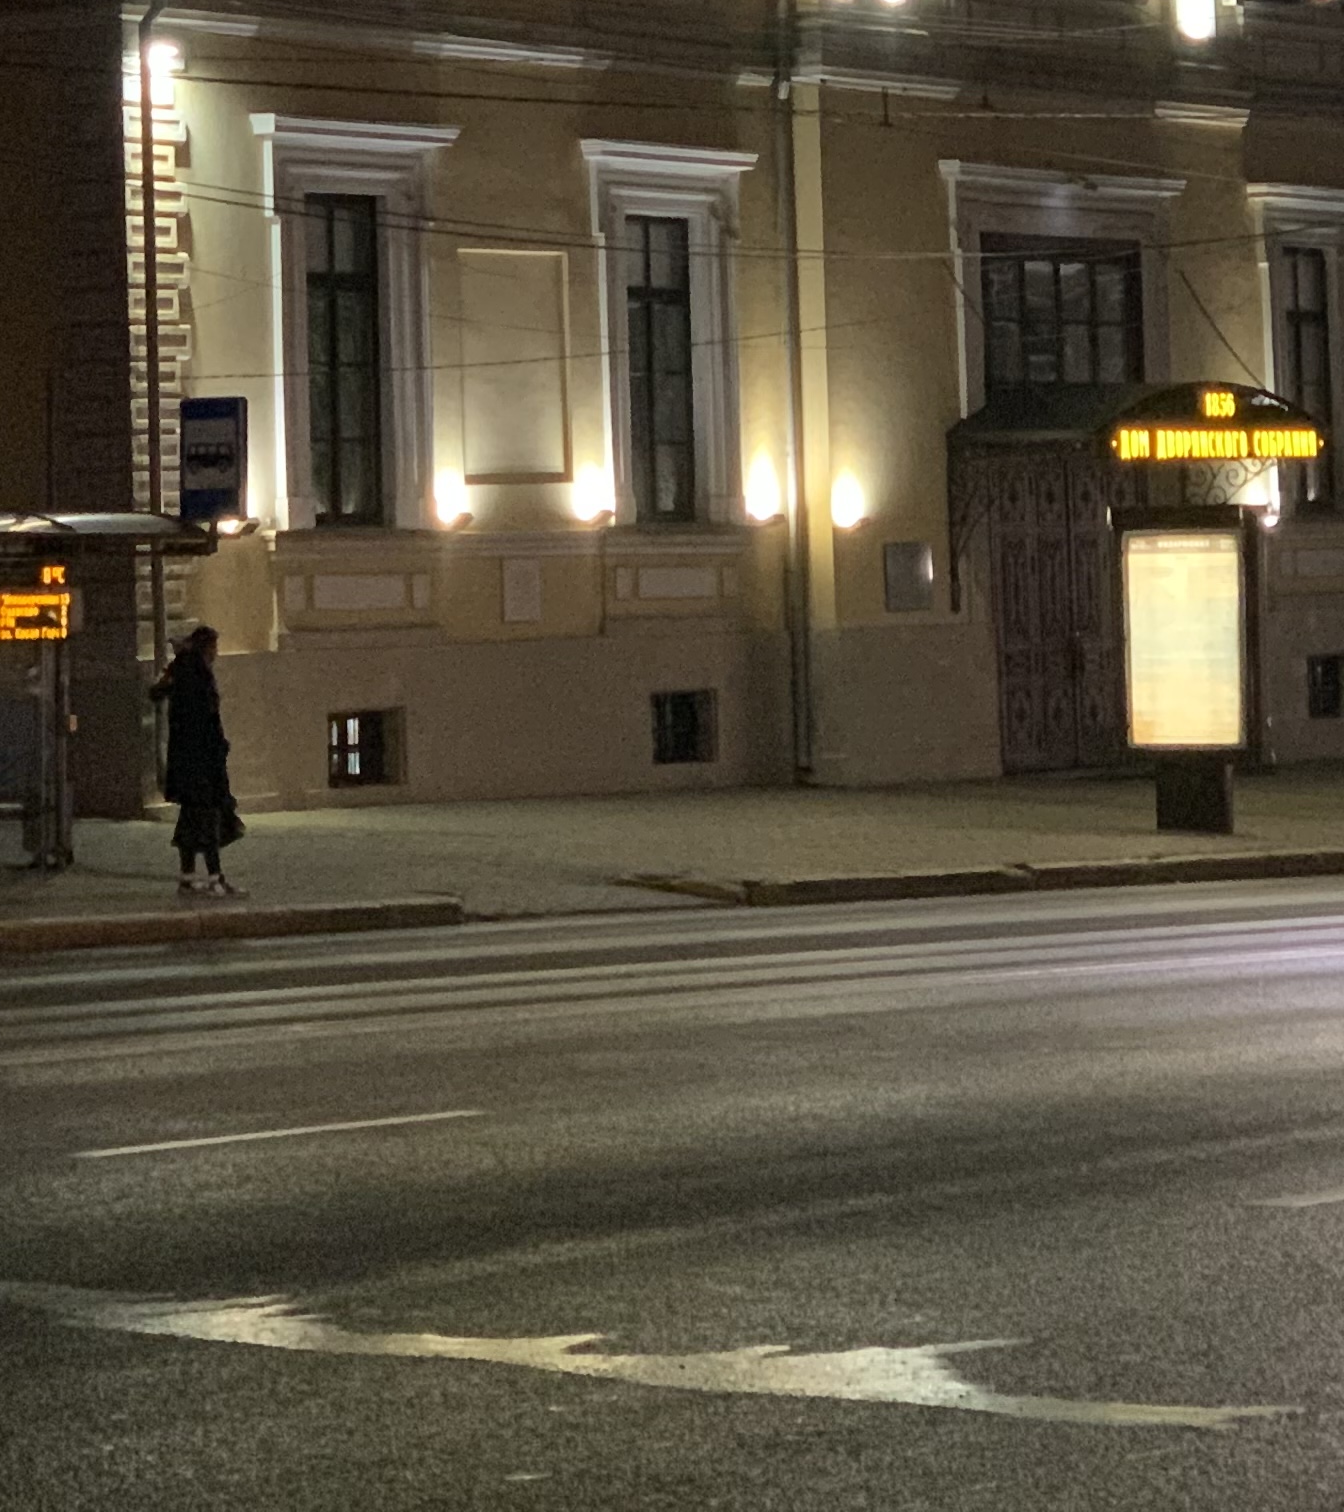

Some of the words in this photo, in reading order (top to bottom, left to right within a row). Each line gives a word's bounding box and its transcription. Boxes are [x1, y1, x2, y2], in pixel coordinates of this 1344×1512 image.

[1204, 392, 1236, 417] 1856
[1120, 429, 1150, 460] ДОМ
[1156, 429, 1248, 460] ДВОРЯНСКОГО
[1254, 429, 1317, 457] СОБРАНИЯ
